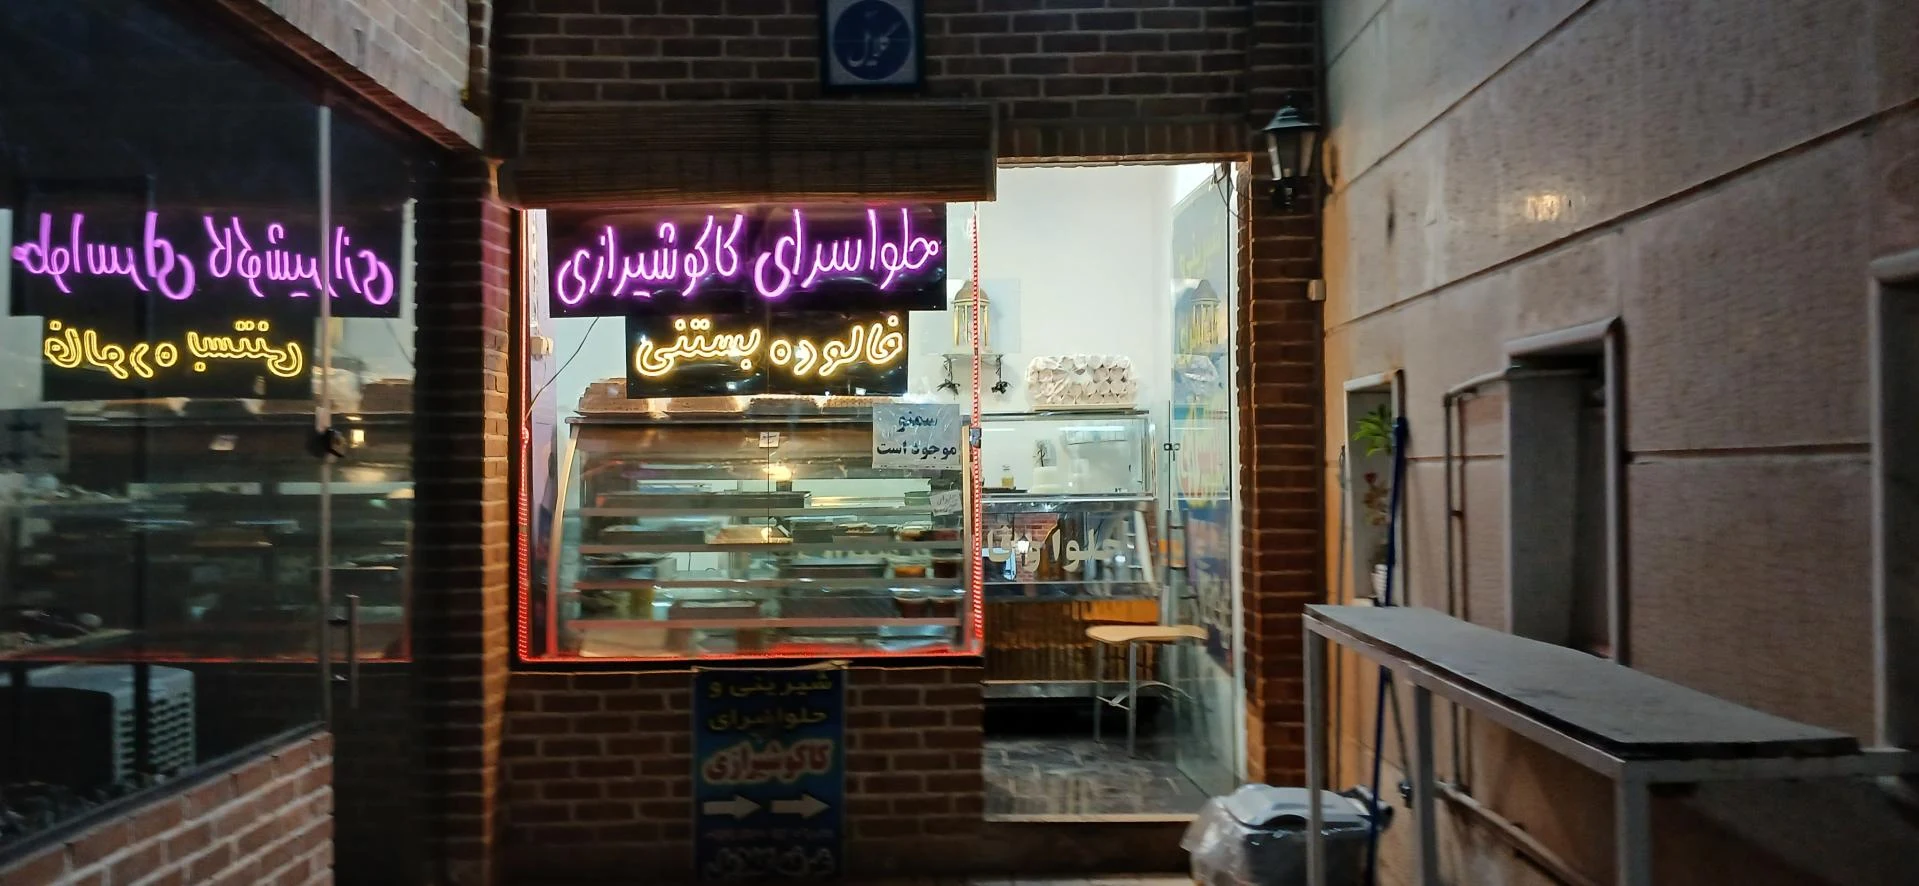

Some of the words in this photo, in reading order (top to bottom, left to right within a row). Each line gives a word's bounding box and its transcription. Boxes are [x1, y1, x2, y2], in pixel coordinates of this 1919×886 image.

[634, 317, 763, 378] بستنی
[769, 315, 905, 378] فالوده
[896, 410, 938, 433] سمنو
[876, 439, 907, 456] است
[911, 442, 957, 460] موجود
[707, 680, 724, 699] و
[728, 671, 834, 698] شیرینی
